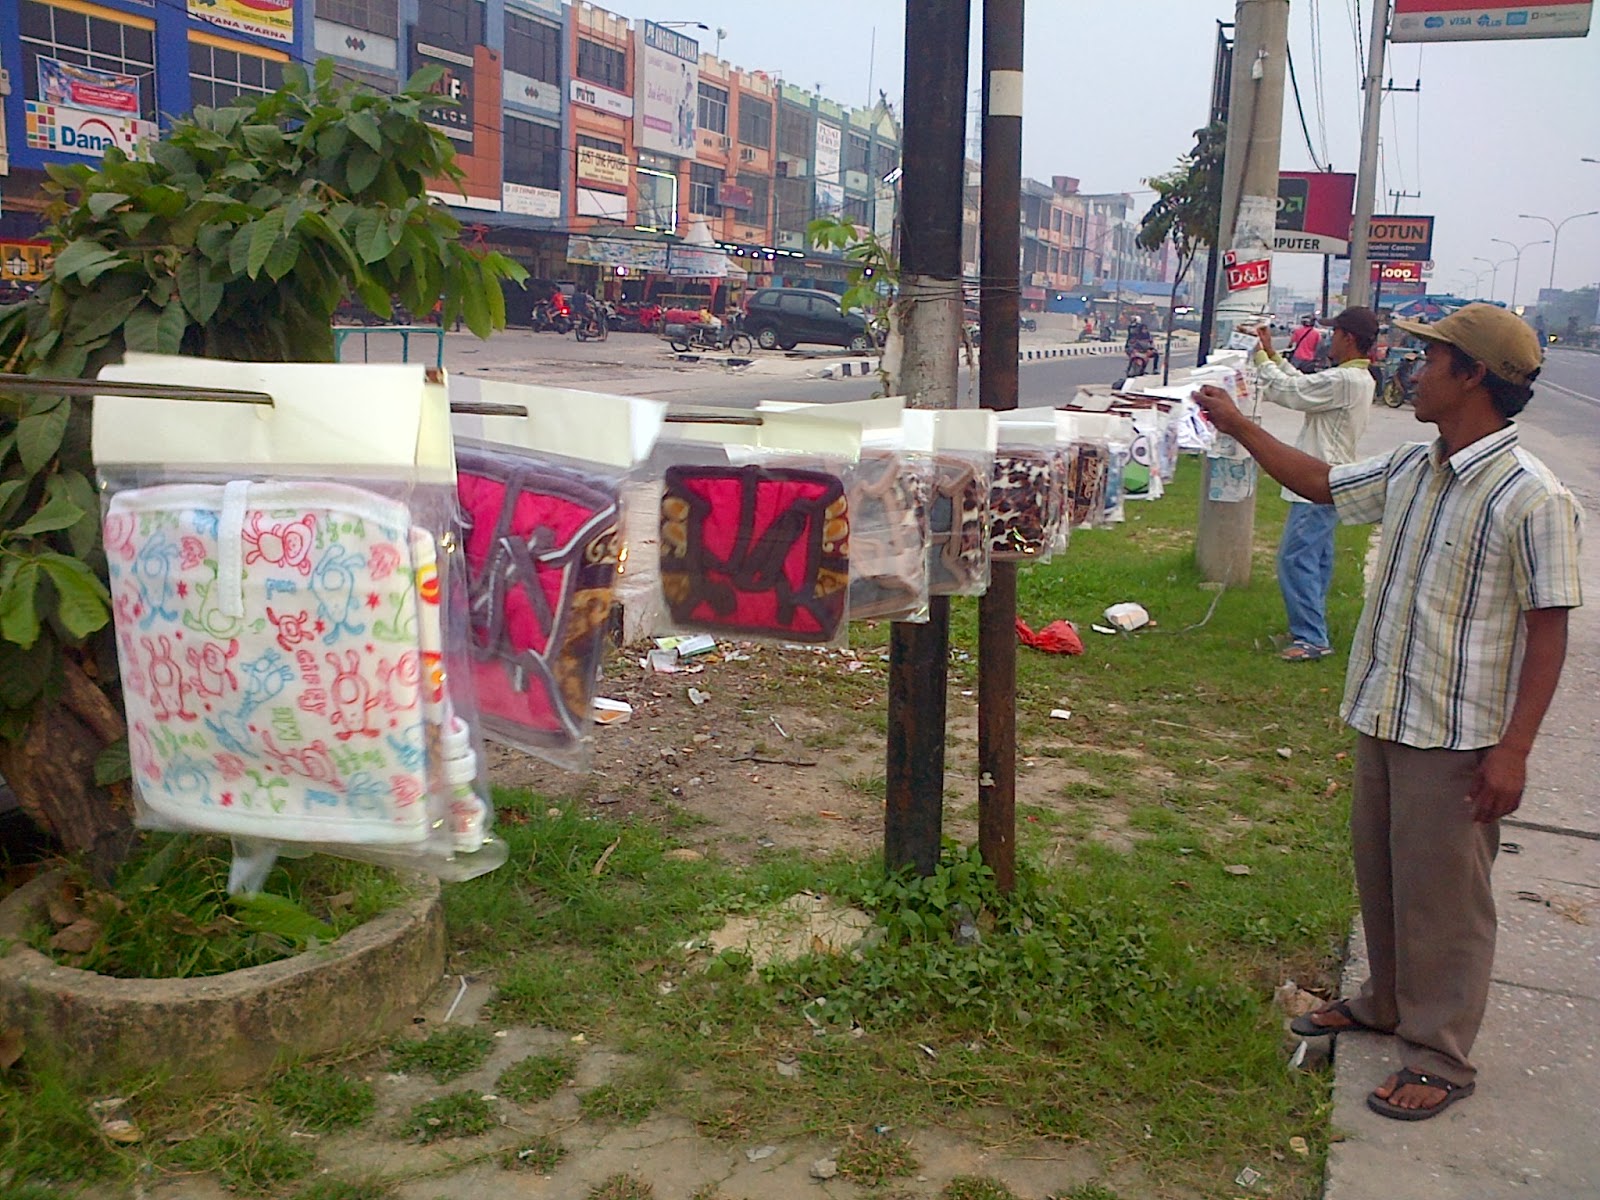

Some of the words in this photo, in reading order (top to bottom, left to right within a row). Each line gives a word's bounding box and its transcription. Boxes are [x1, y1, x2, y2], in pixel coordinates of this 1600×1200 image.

[1449, 15, 1472, 26] VISA
[243, 24, 287, 39] WARNA
[61, 125, 114, 151] Dana
